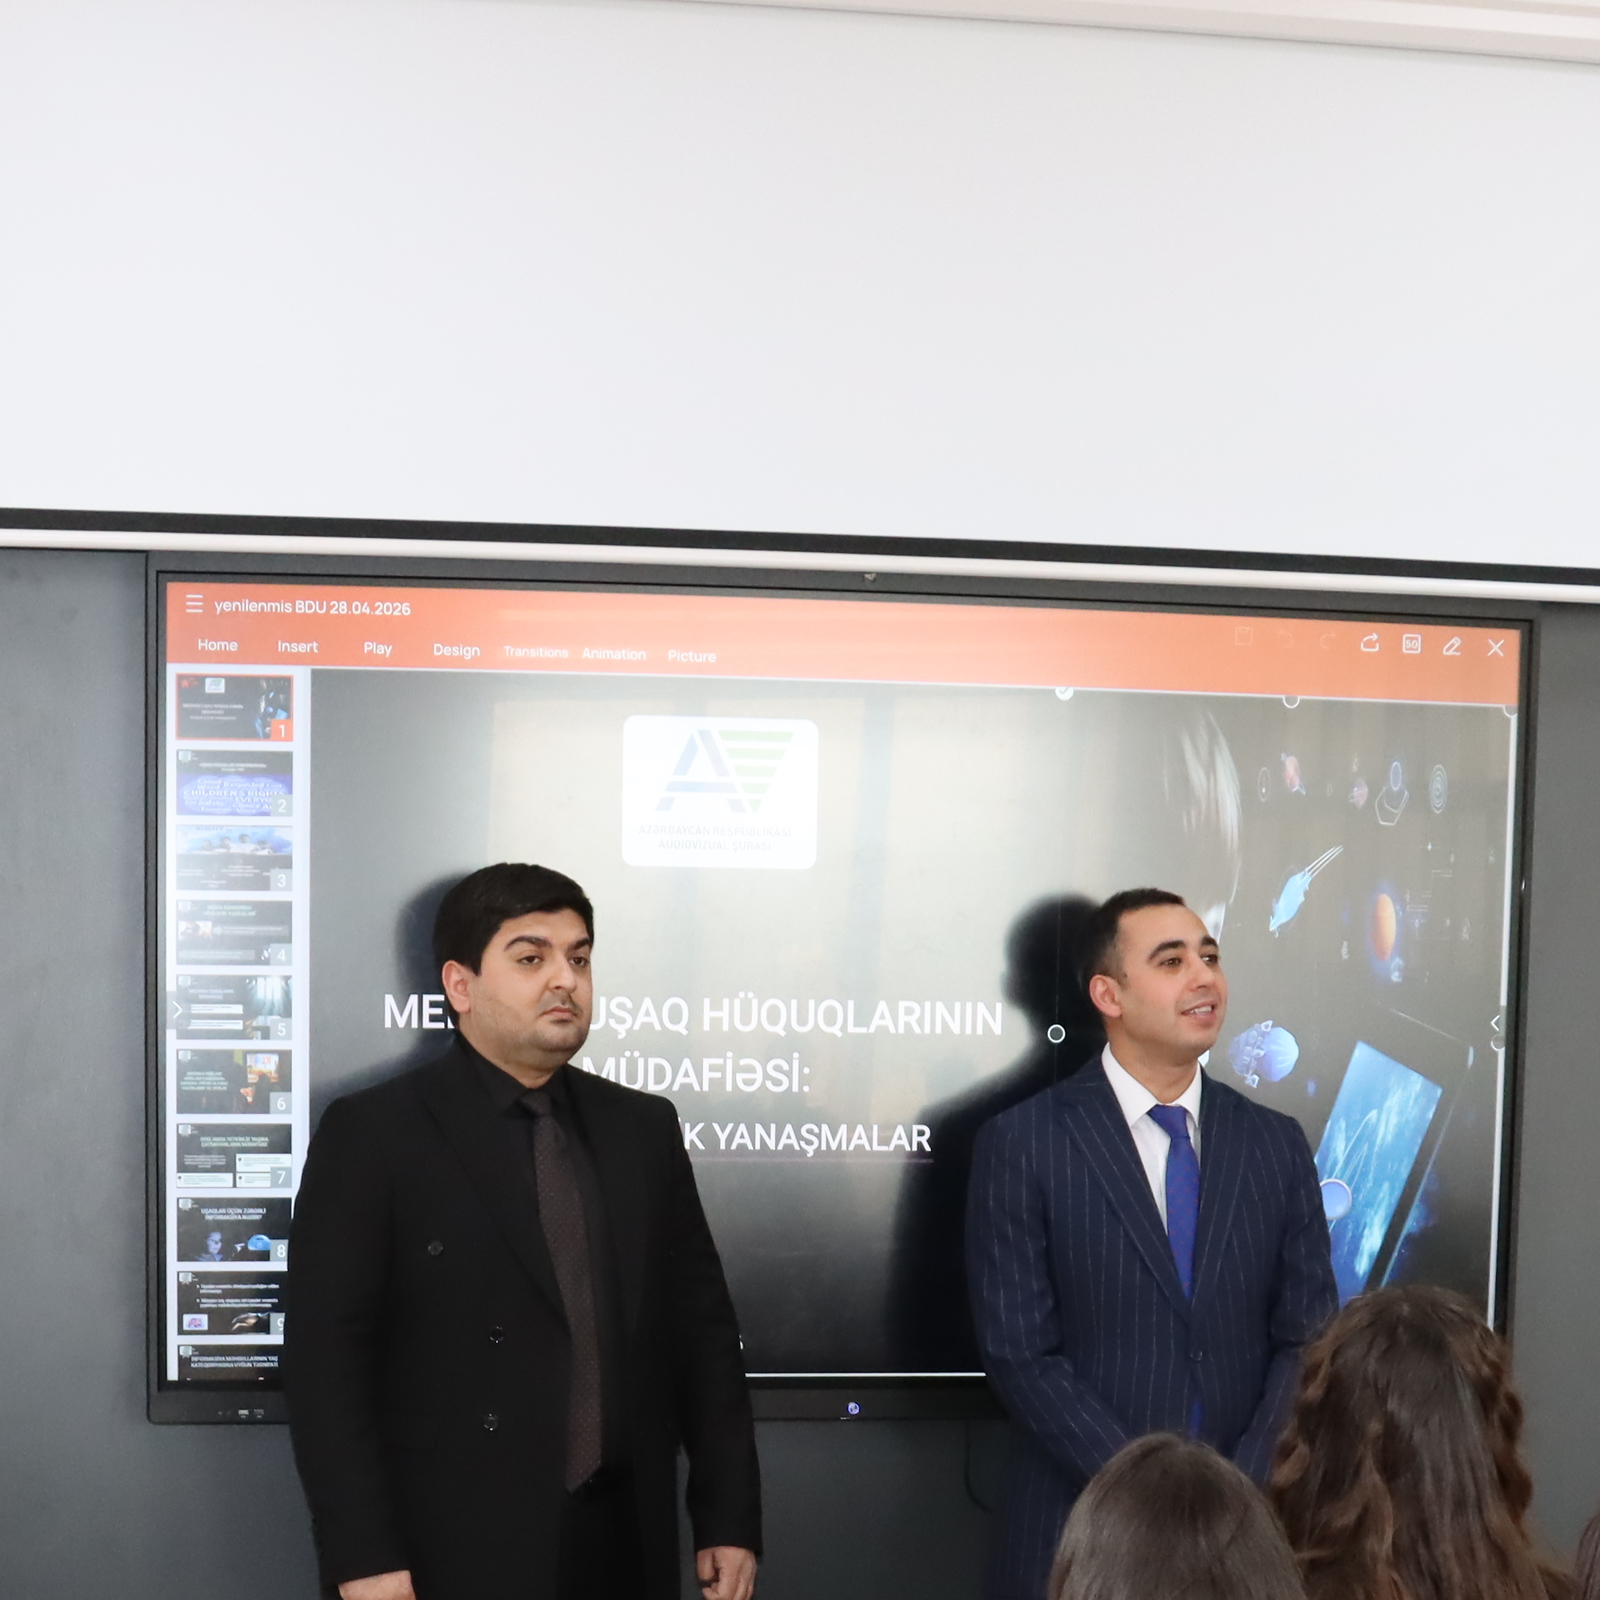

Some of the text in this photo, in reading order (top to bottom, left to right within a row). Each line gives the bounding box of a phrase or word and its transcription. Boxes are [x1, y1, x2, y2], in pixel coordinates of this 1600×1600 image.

[214, 598, 412, 615] yenilenmis BDU 28.04.2026
[197, 638, 717, 663] Home Insert Play Design Transitions Animation Picture
[1405, 639, 1419, 649] 50
[278, 724, 286, 738] 1
[277, 799, 287, 813] 2
[638, 824, 711, 836] AZƏRBAYCAN
[277, 873, 286, 887] 3
[277, 948, 286, 961] 4
[702, 991, 1003, 1038] HÜQUQLARININ
[277, 1022, 287, 1036] 5
[582, 1050, 811, 1092] MÜDAFİƏSİ:
[277, 1097, 286, 1110] 6
[712, 1122, 932, 1157] YANAŞMALAR
[276, 1170, 286, 1184] 7
[277, 1244, 286, 1257] 8
[277, 1317, 285, 1330] 9
